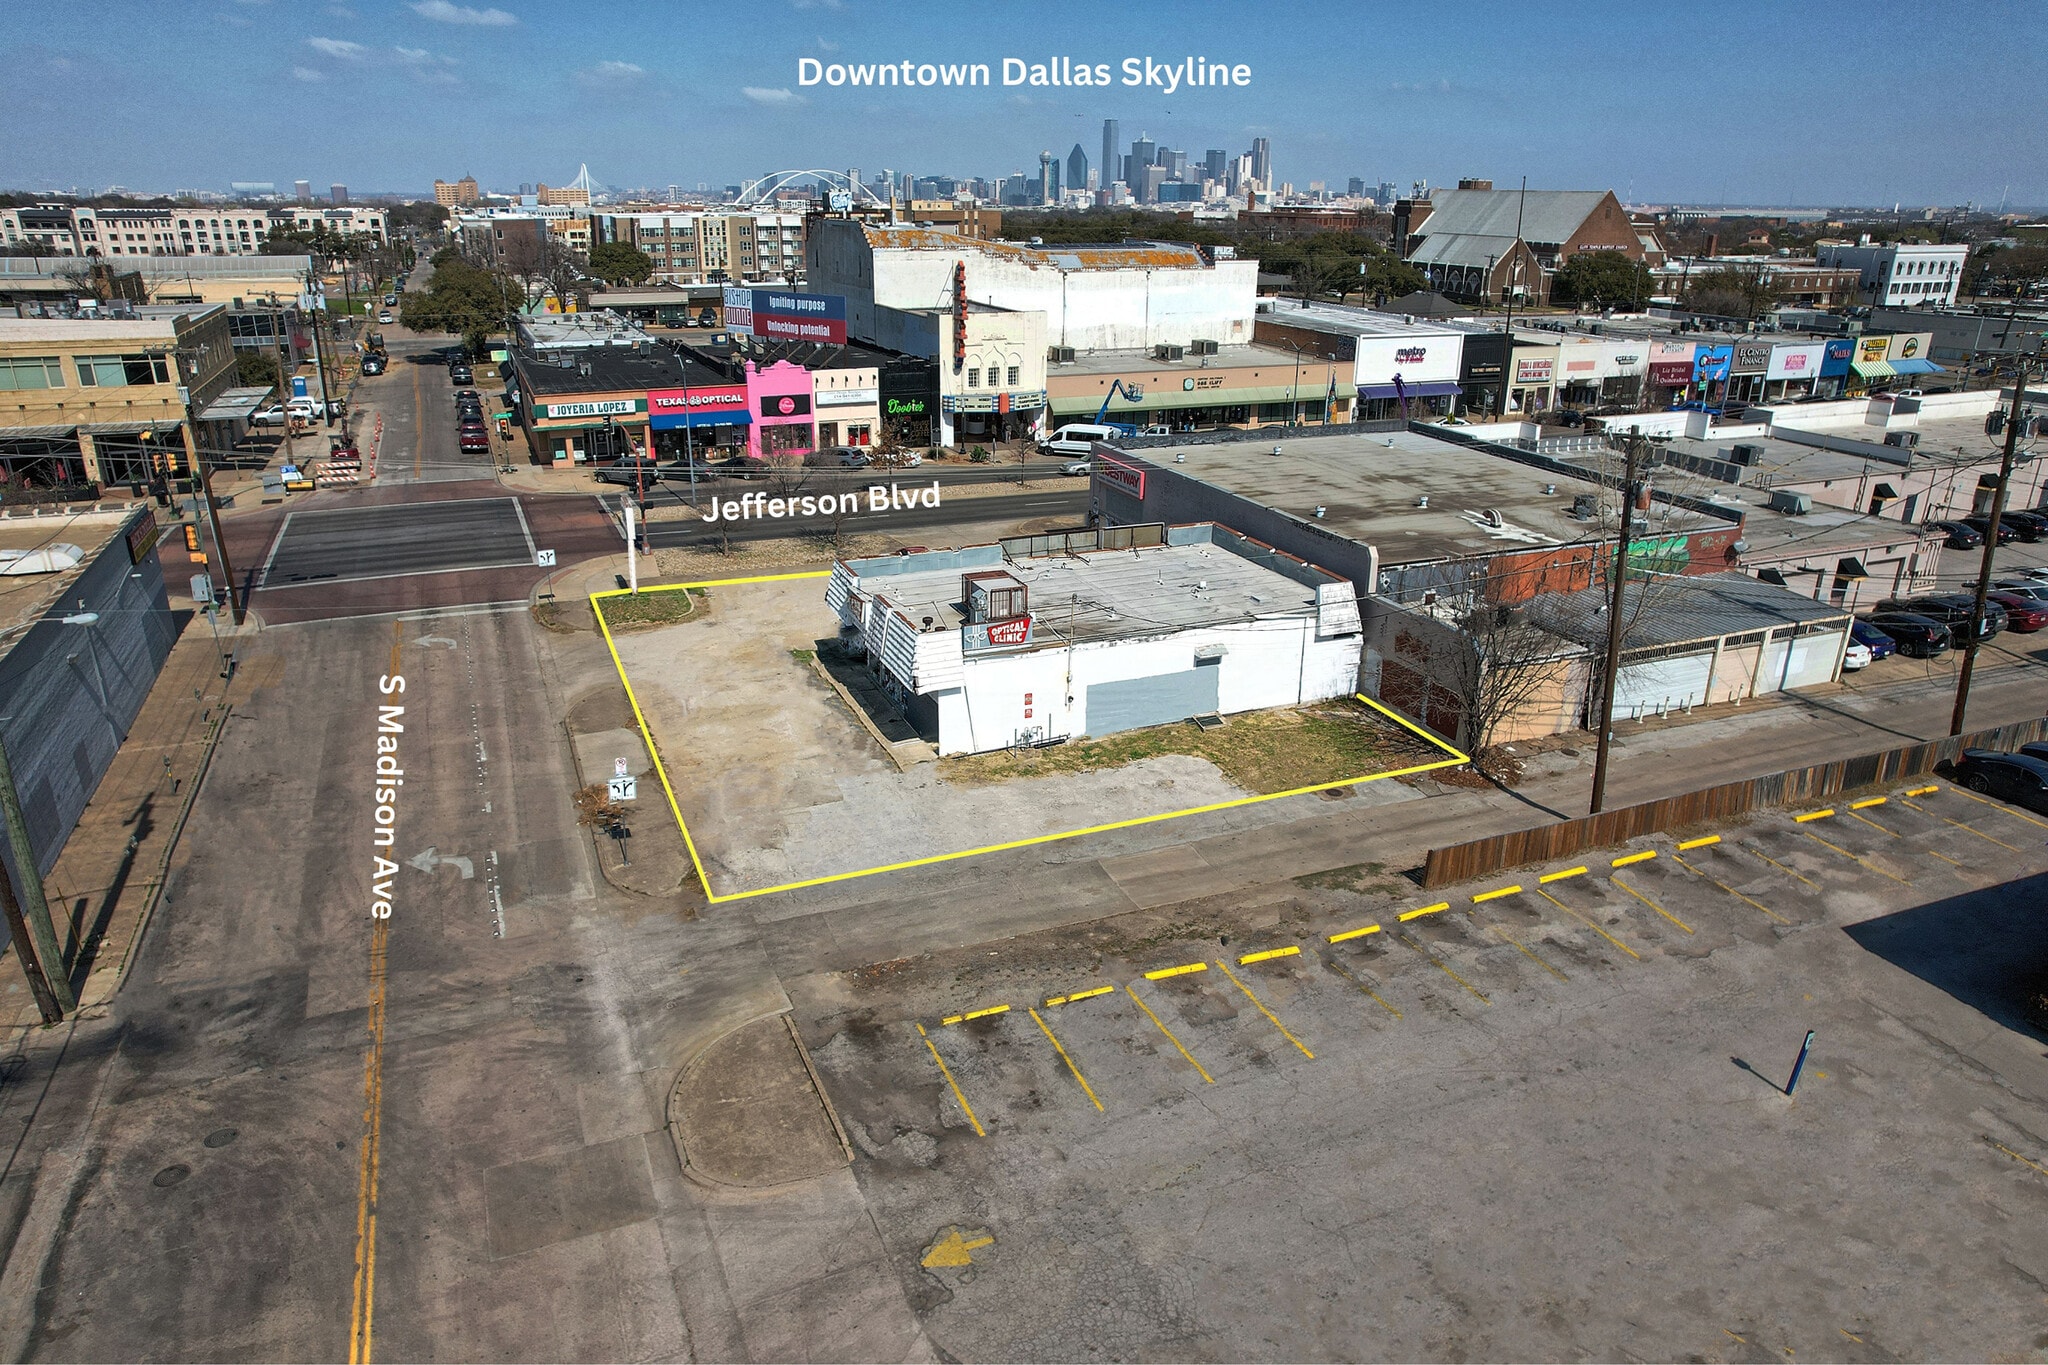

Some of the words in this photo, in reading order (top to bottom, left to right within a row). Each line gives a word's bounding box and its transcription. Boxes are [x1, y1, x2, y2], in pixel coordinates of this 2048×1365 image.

[724, 288, 751, 306] BISHOP
[769, 295, 796, 309] Igniting
[796, 299, 826, 311] purpose
[767, 320, 799, 334] Unlocking
[800, 323, 830, 336] potential
[1397, 346, 1426, 356] metro
[656, 397, 689, 407] TEXAS
[702, 394, 743, 404] OPTICAL
[557, 404, 595, 415] JOYERIA
[598, 402, 627, 413] LOPEZ
[991, 621, 1026, 635] OPTICAL
[994, 632, 1023, 643] CLINIC
